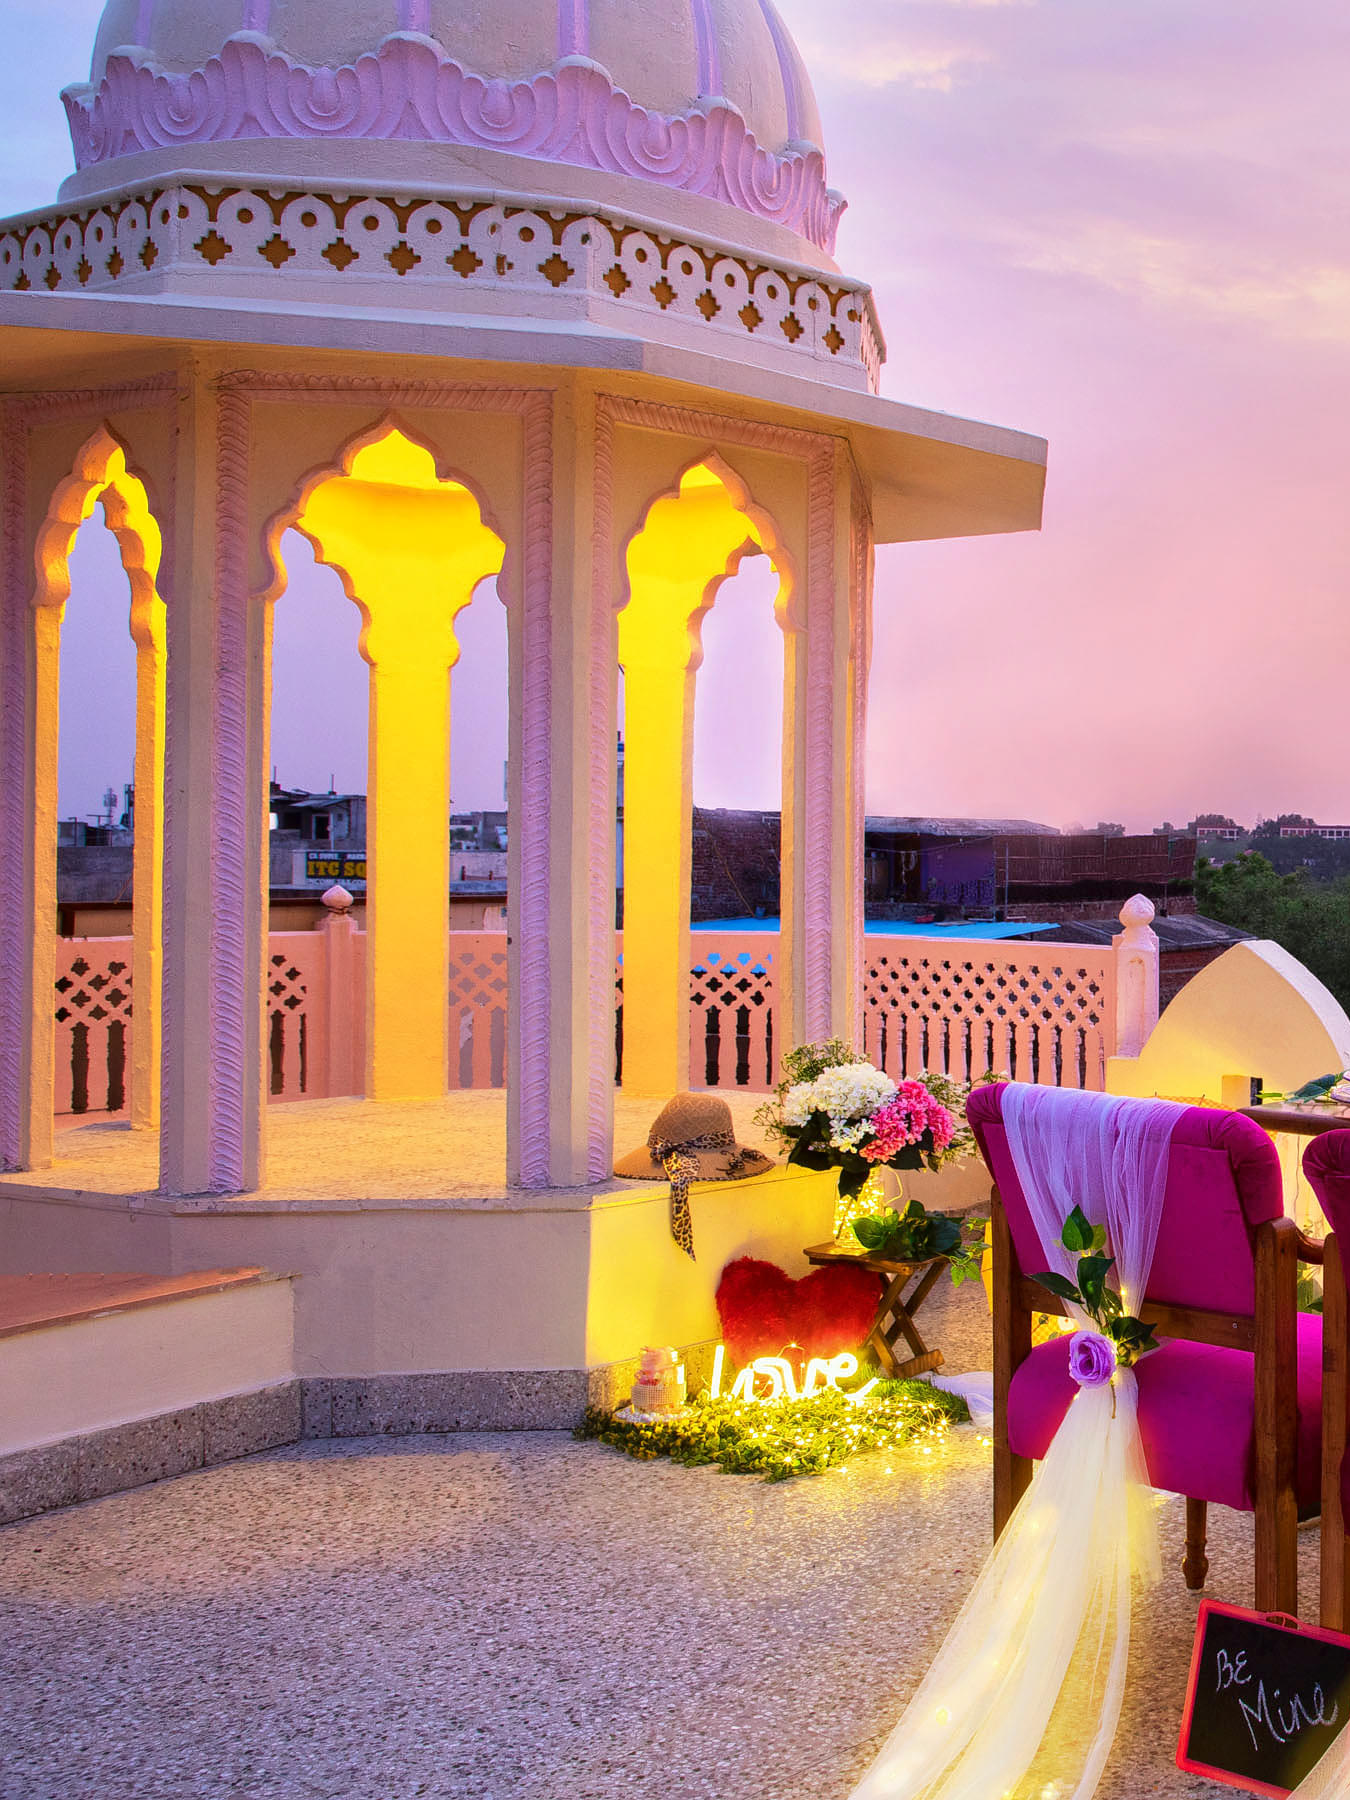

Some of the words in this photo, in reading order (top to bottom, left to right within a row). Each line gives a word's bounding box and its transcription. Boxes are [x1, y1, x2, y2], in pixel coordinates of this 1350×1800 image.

[307, 861, 340, 877] ITC
[1216, 1649, 1252, 1692] BE
[1238, 1679, 1339, 1751] Mine
